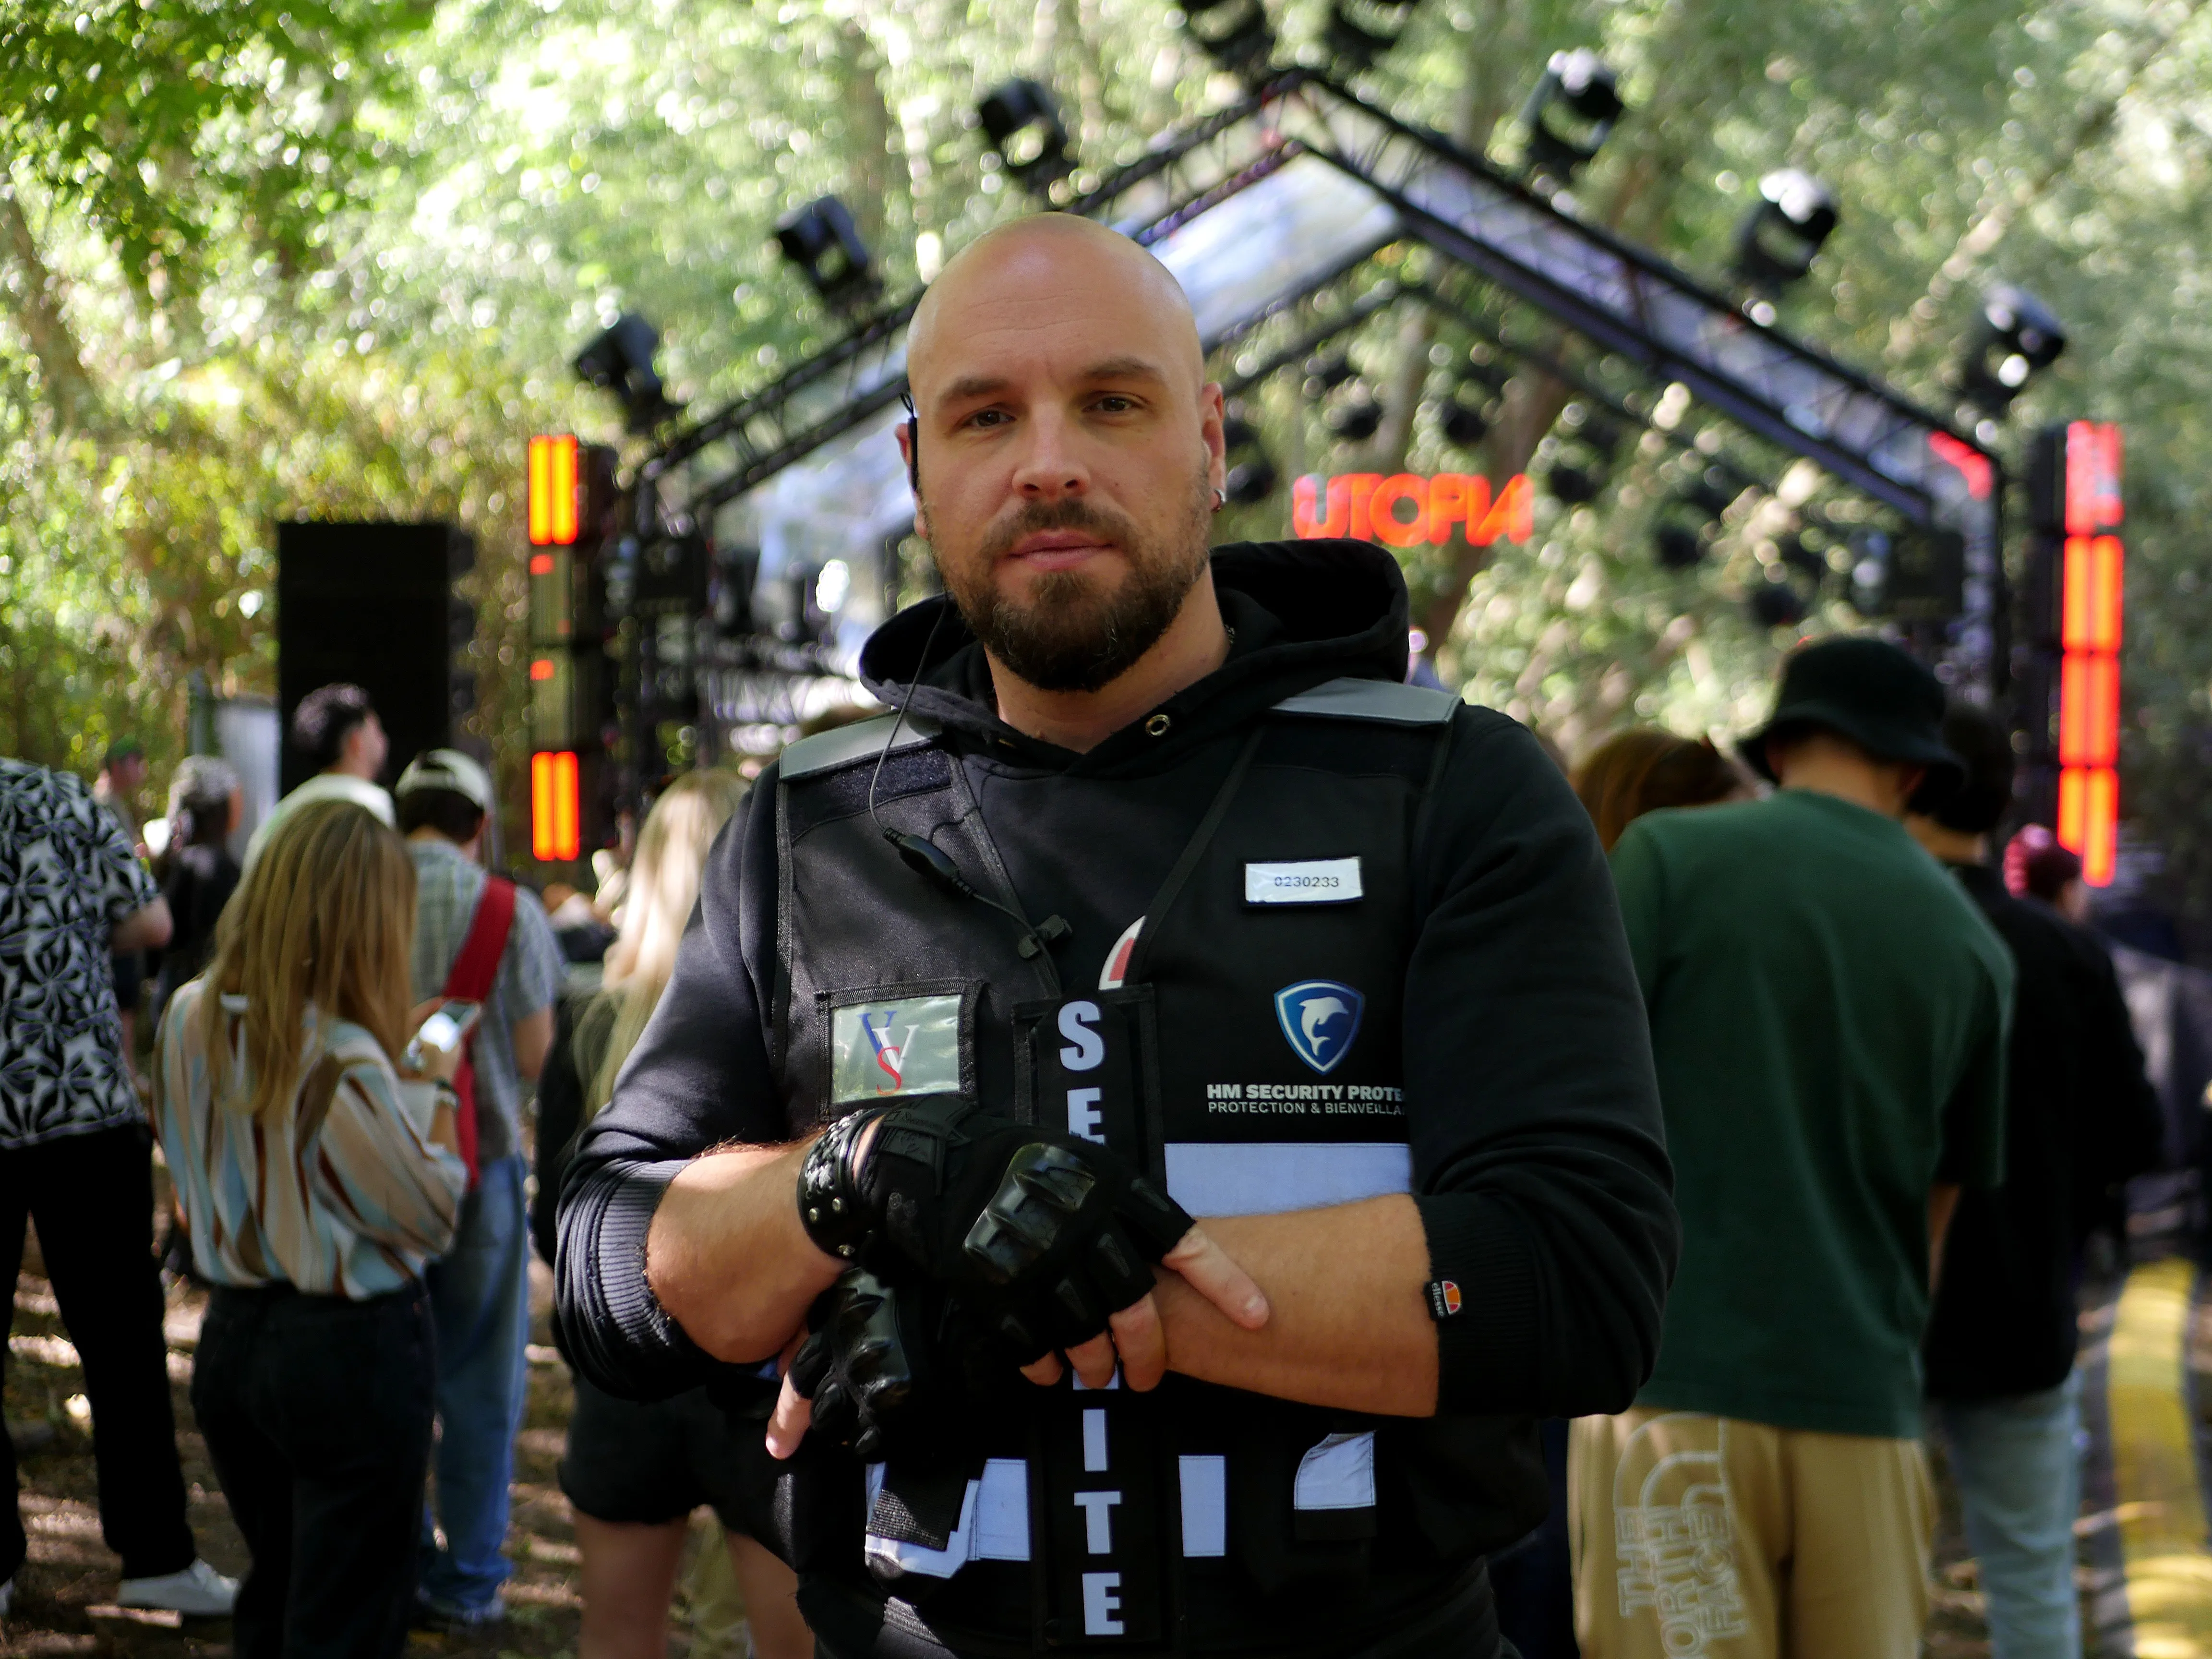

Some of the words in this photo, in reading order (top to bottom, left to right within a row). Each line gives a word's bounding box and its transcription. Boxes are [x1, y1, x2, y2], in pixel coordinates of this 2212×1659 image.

[1293, 472, 1534, 548] UTOPIA
[1274, 877, 1339, 887] 0230233
[1207, 1084, 1241, 1099] HM
[1246, 1084, 1344, 1100] SECURITY
[1347, 1085, 1405, 1102] PROTE
[1208, 1102, 1305, 1113] PROTECTION
[1310, 1103, 1321, 1114] &
[1325, 1103, 1405, 1116] BIENVEILLA
[1431, 1282, 1444, 1317] ellesse
[1644, 1506, 1711, 1659] ORTH
